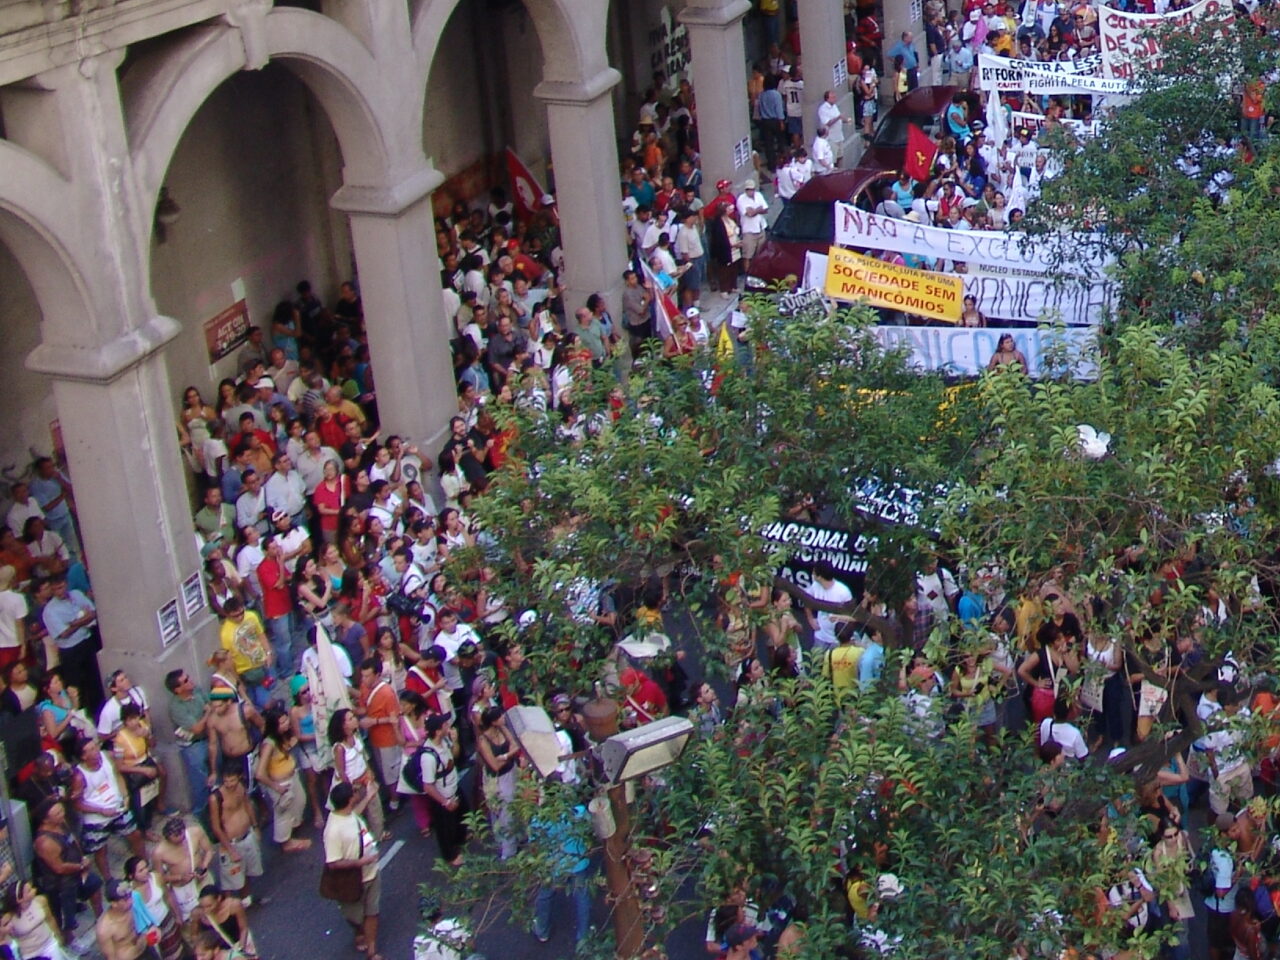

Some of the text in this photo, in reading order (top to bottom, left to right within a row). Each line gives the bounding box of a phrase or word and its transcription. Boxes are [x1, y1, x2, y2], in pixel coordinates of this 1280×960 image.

[833, 263, 956, 302] SOCIEDADE SEM
[937, 277, 956, 287] UMA
